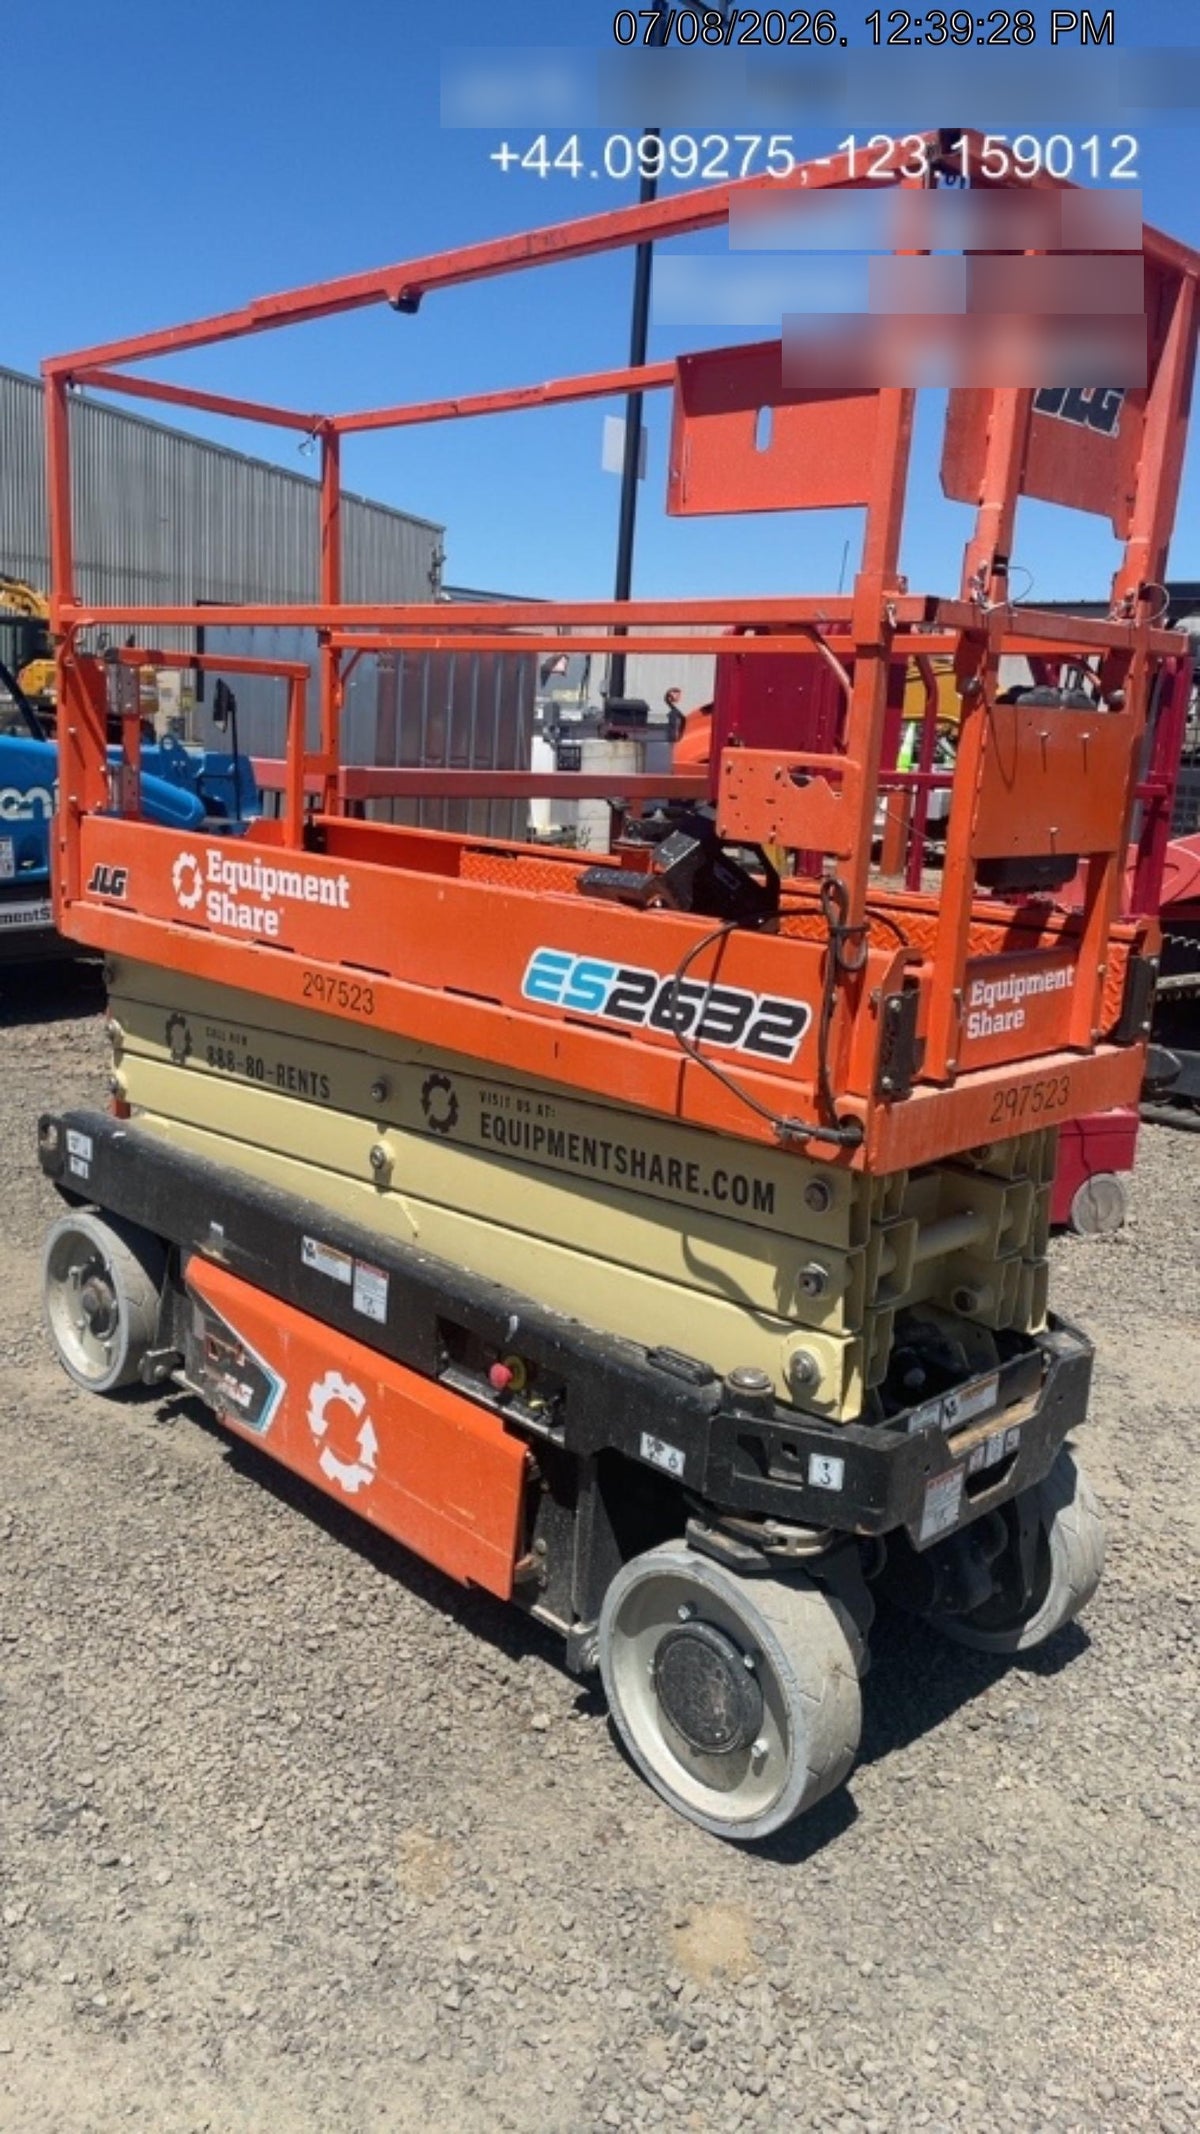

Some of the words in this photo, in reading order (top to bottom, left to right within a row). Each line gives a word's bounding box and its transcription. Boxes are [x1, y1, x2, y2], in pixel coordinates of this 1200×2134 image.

[88, 864, 127, 898] JLG
[206, 849, 349, 909] Equipment
[206, 890, 279, 936] Share
[303, 971, 375, 1016] 297523
[522, 947, 811, 1063] ES2632
[969, 964, 1075, 1008] Equipment
[967, 1009, 1025, 1039] Share
[206, 1045, 331, 1099] 888-80-RENTS
[479, 1091, 511, 1109] VISIT
[990, 1075, 1071, 1123] 297523
[480, 1111, 775, 1215] EQUIPMENTSHARE.COM
